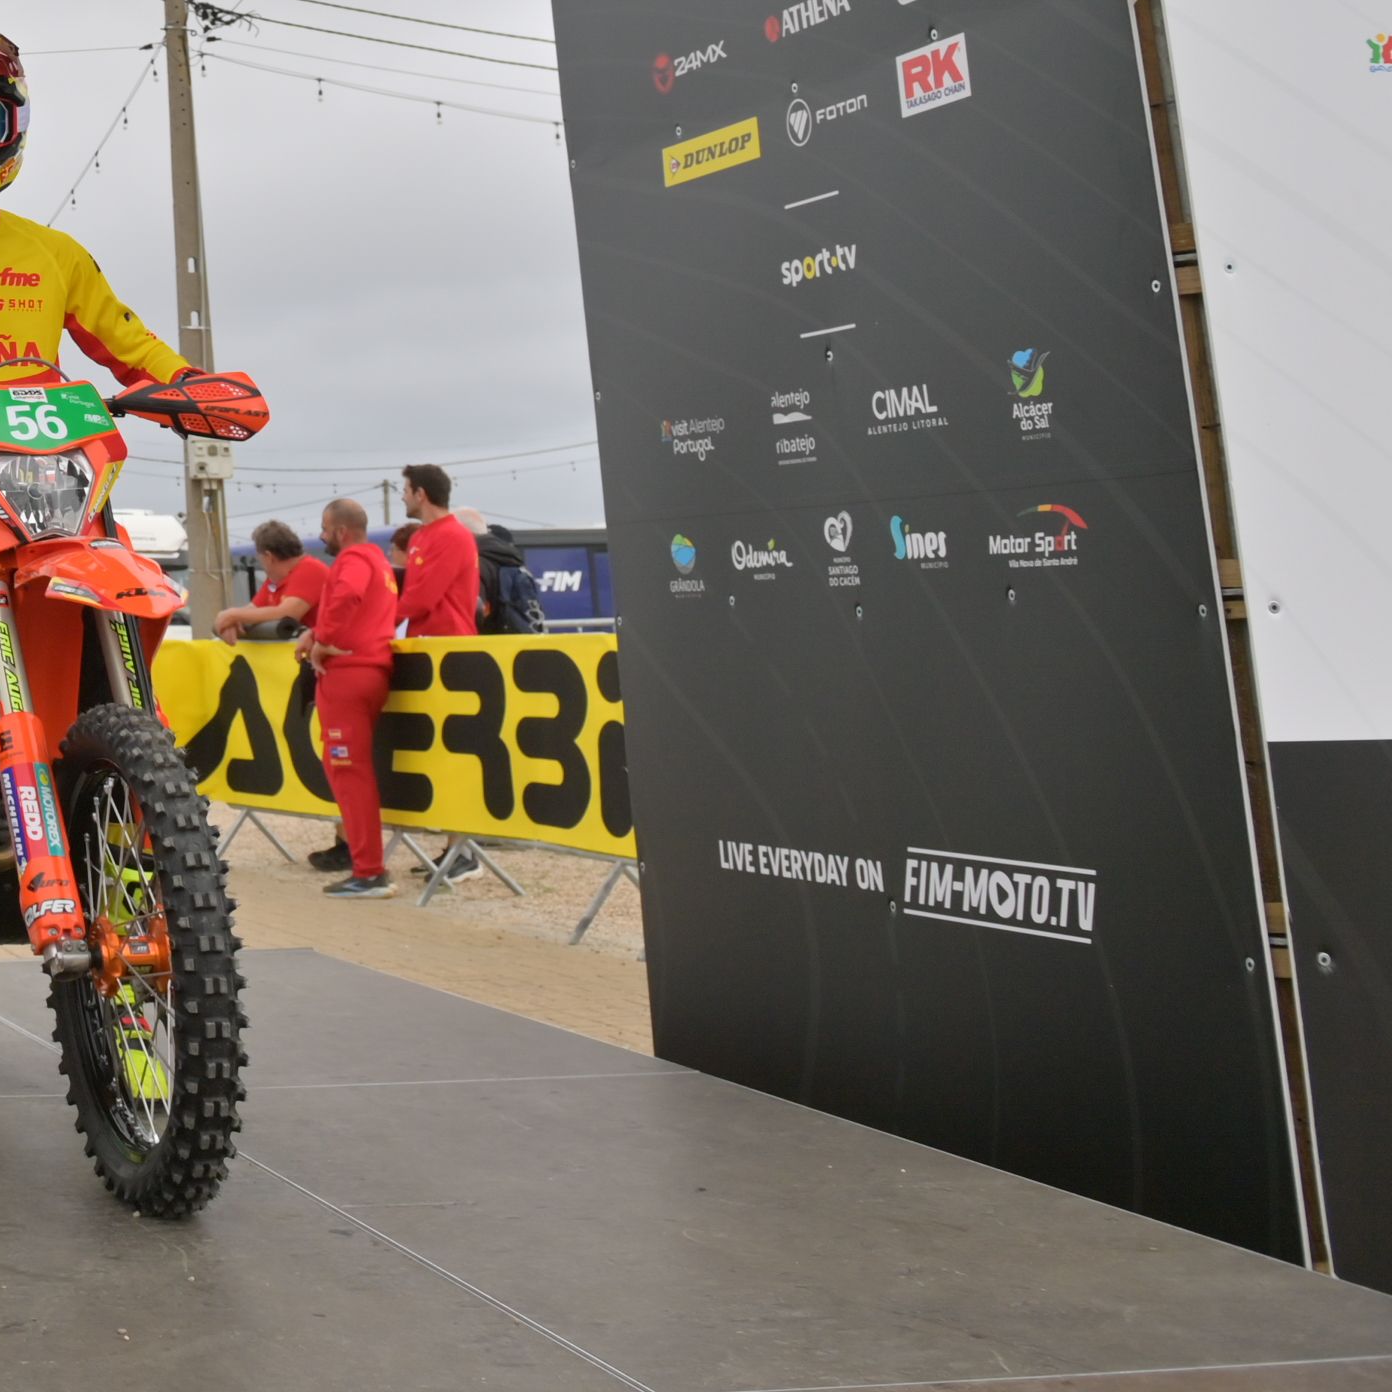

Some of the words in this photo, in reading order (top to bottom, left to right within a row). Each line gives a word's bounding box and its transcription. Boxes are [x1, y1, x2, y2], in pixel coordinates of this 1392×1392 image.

[674, 40, 727, 78] 24MX
[902, 41, 964, 100] RK
[816, 94, 867, 124] FOTON
[682, 132, 752, 170] DUNLOP
[8, 299, 43, 309] SHOT
[771, 389, 810, 409] alentejo
[872, 384, 938, 420] CIMAL
[1012, 401, 1053, 419] Alcácer
[5, 404, 68, 440] 56
[672, 420, 689, 436] visit
[689, 416, 725, 435] Alentejo
[867, 423, 909, 436] ALENTEJO
[913, 417, 949, 430] LITORAL
[1020, 417, 1033, 431] do
[1034, 415, 1050, 429] Sal
[673, 437, 715, 461] Portugal
[776, 434, 815, 455] ribatejo
[890, 515, 947, 560] Sines
[989, 534, 1031, 555] Motor
[1034, 530, 1078, 556] Sport
[731, 540, 793, 571] Odemira
[536, 570, 582, 592] FIM
[828, 564, 859, 576] SANTIAGO
[829, 577, 839, 587] DO
[2, 773, 24, 859] MICHELIN
[18, 785, 44, 841] REDD
[40, 786, 62, 848] MOTOREX
[719, 839, 755, 873] LIVE
[758, 845, 849, 887] EVERYDAY
[855, 858, 884, 892] ON
[904, 858, 1096, 931] FIM-MOTO.TV
